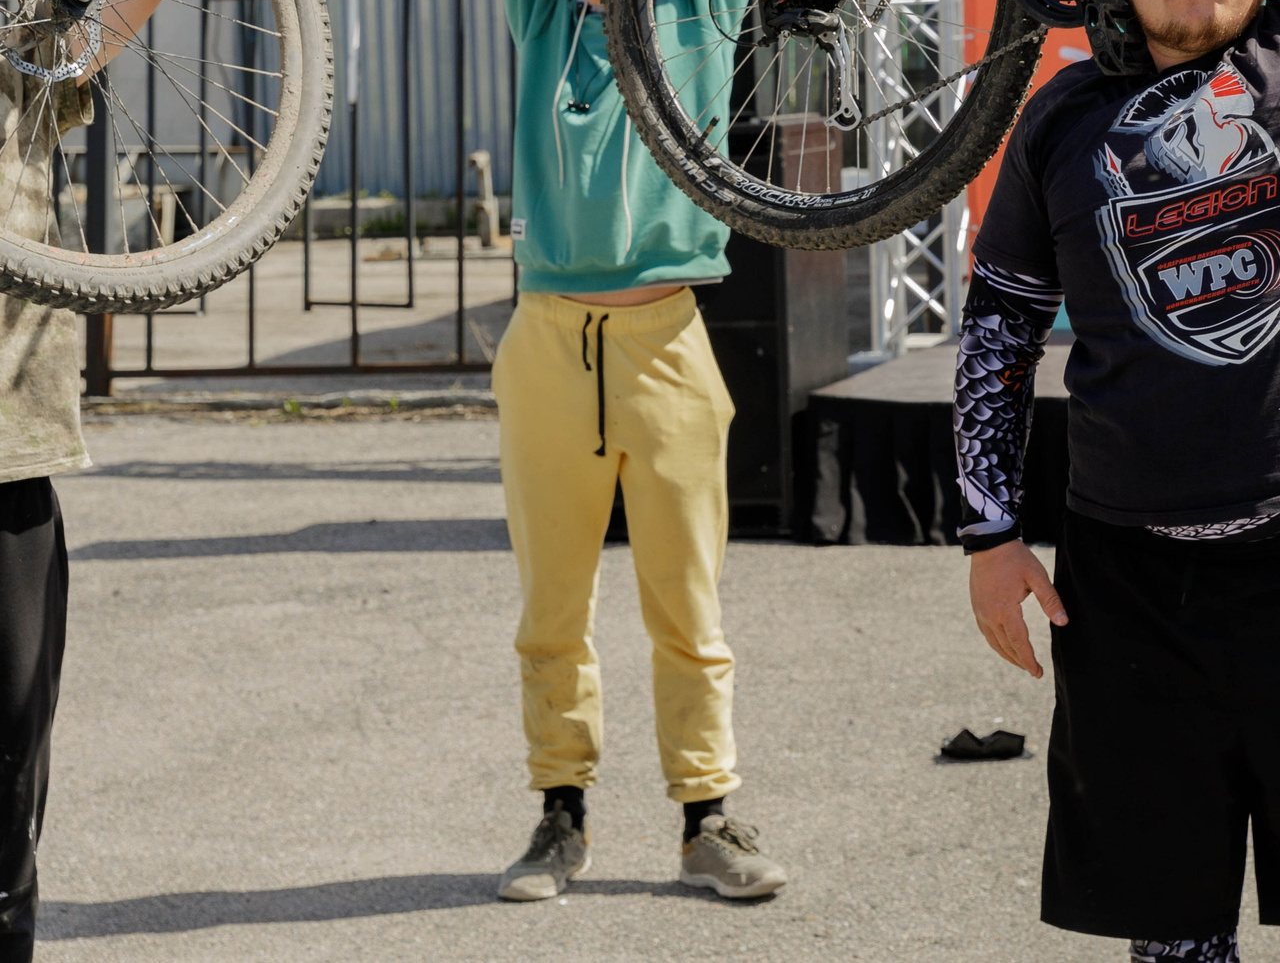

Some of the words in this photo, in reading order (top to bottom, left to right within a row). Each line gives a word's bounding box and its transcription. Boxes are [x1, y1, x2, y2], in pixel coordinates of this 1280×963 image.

[1126, 174, 1278, 238] LEGION
[1157, 254, 1196, 271] ФЕДЕРАЦИЯ
[1157, 248, 1258, 301] WPC
[1165, 287, 1226, 311] НОВОСИБИРСКОЙ
